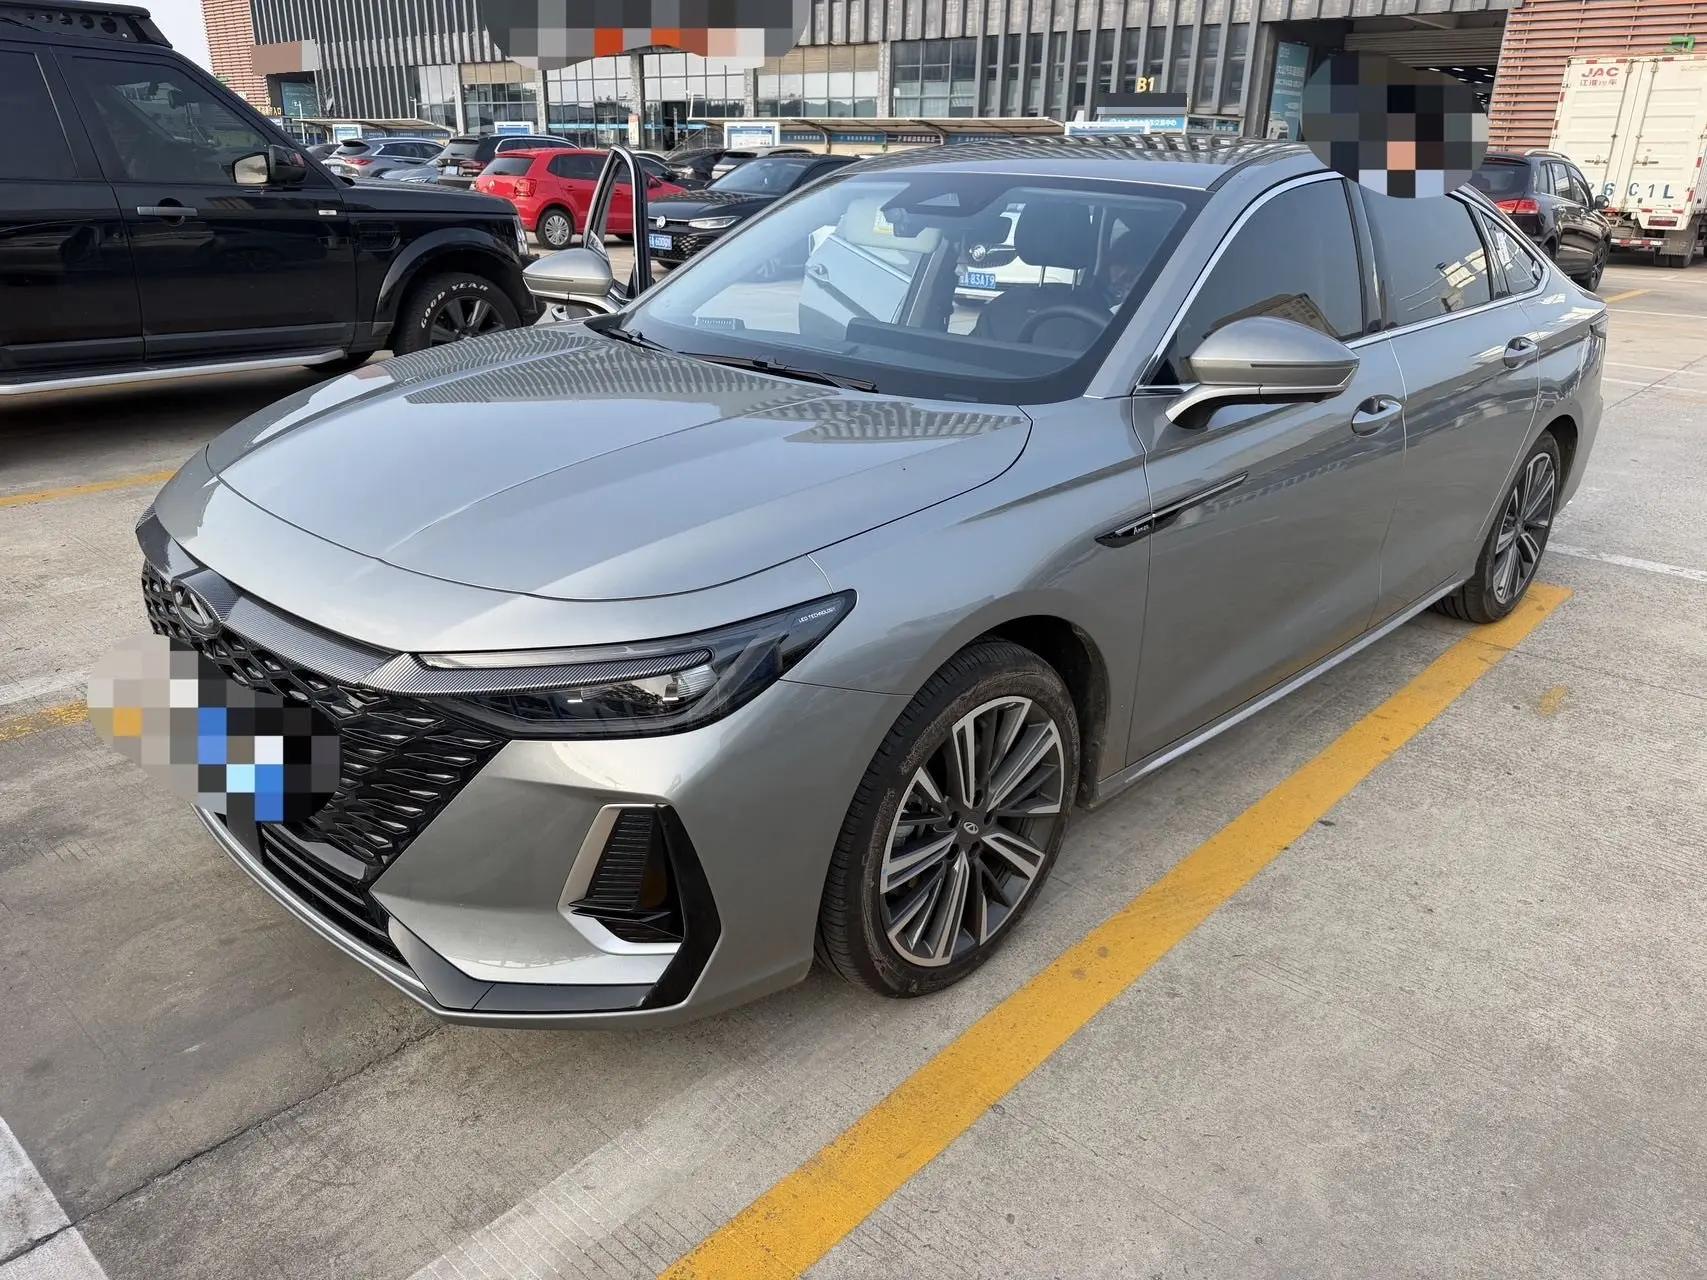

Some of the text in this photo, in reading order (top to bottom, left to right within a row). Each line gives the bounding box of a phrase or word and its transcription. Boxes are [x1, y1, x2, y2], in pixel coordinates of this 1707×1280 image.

[1581, 67, 1619, 78] JAC
[1136, 76, 1155, 93] B1
[421, 282, 489, 328] GOOD YEAR
